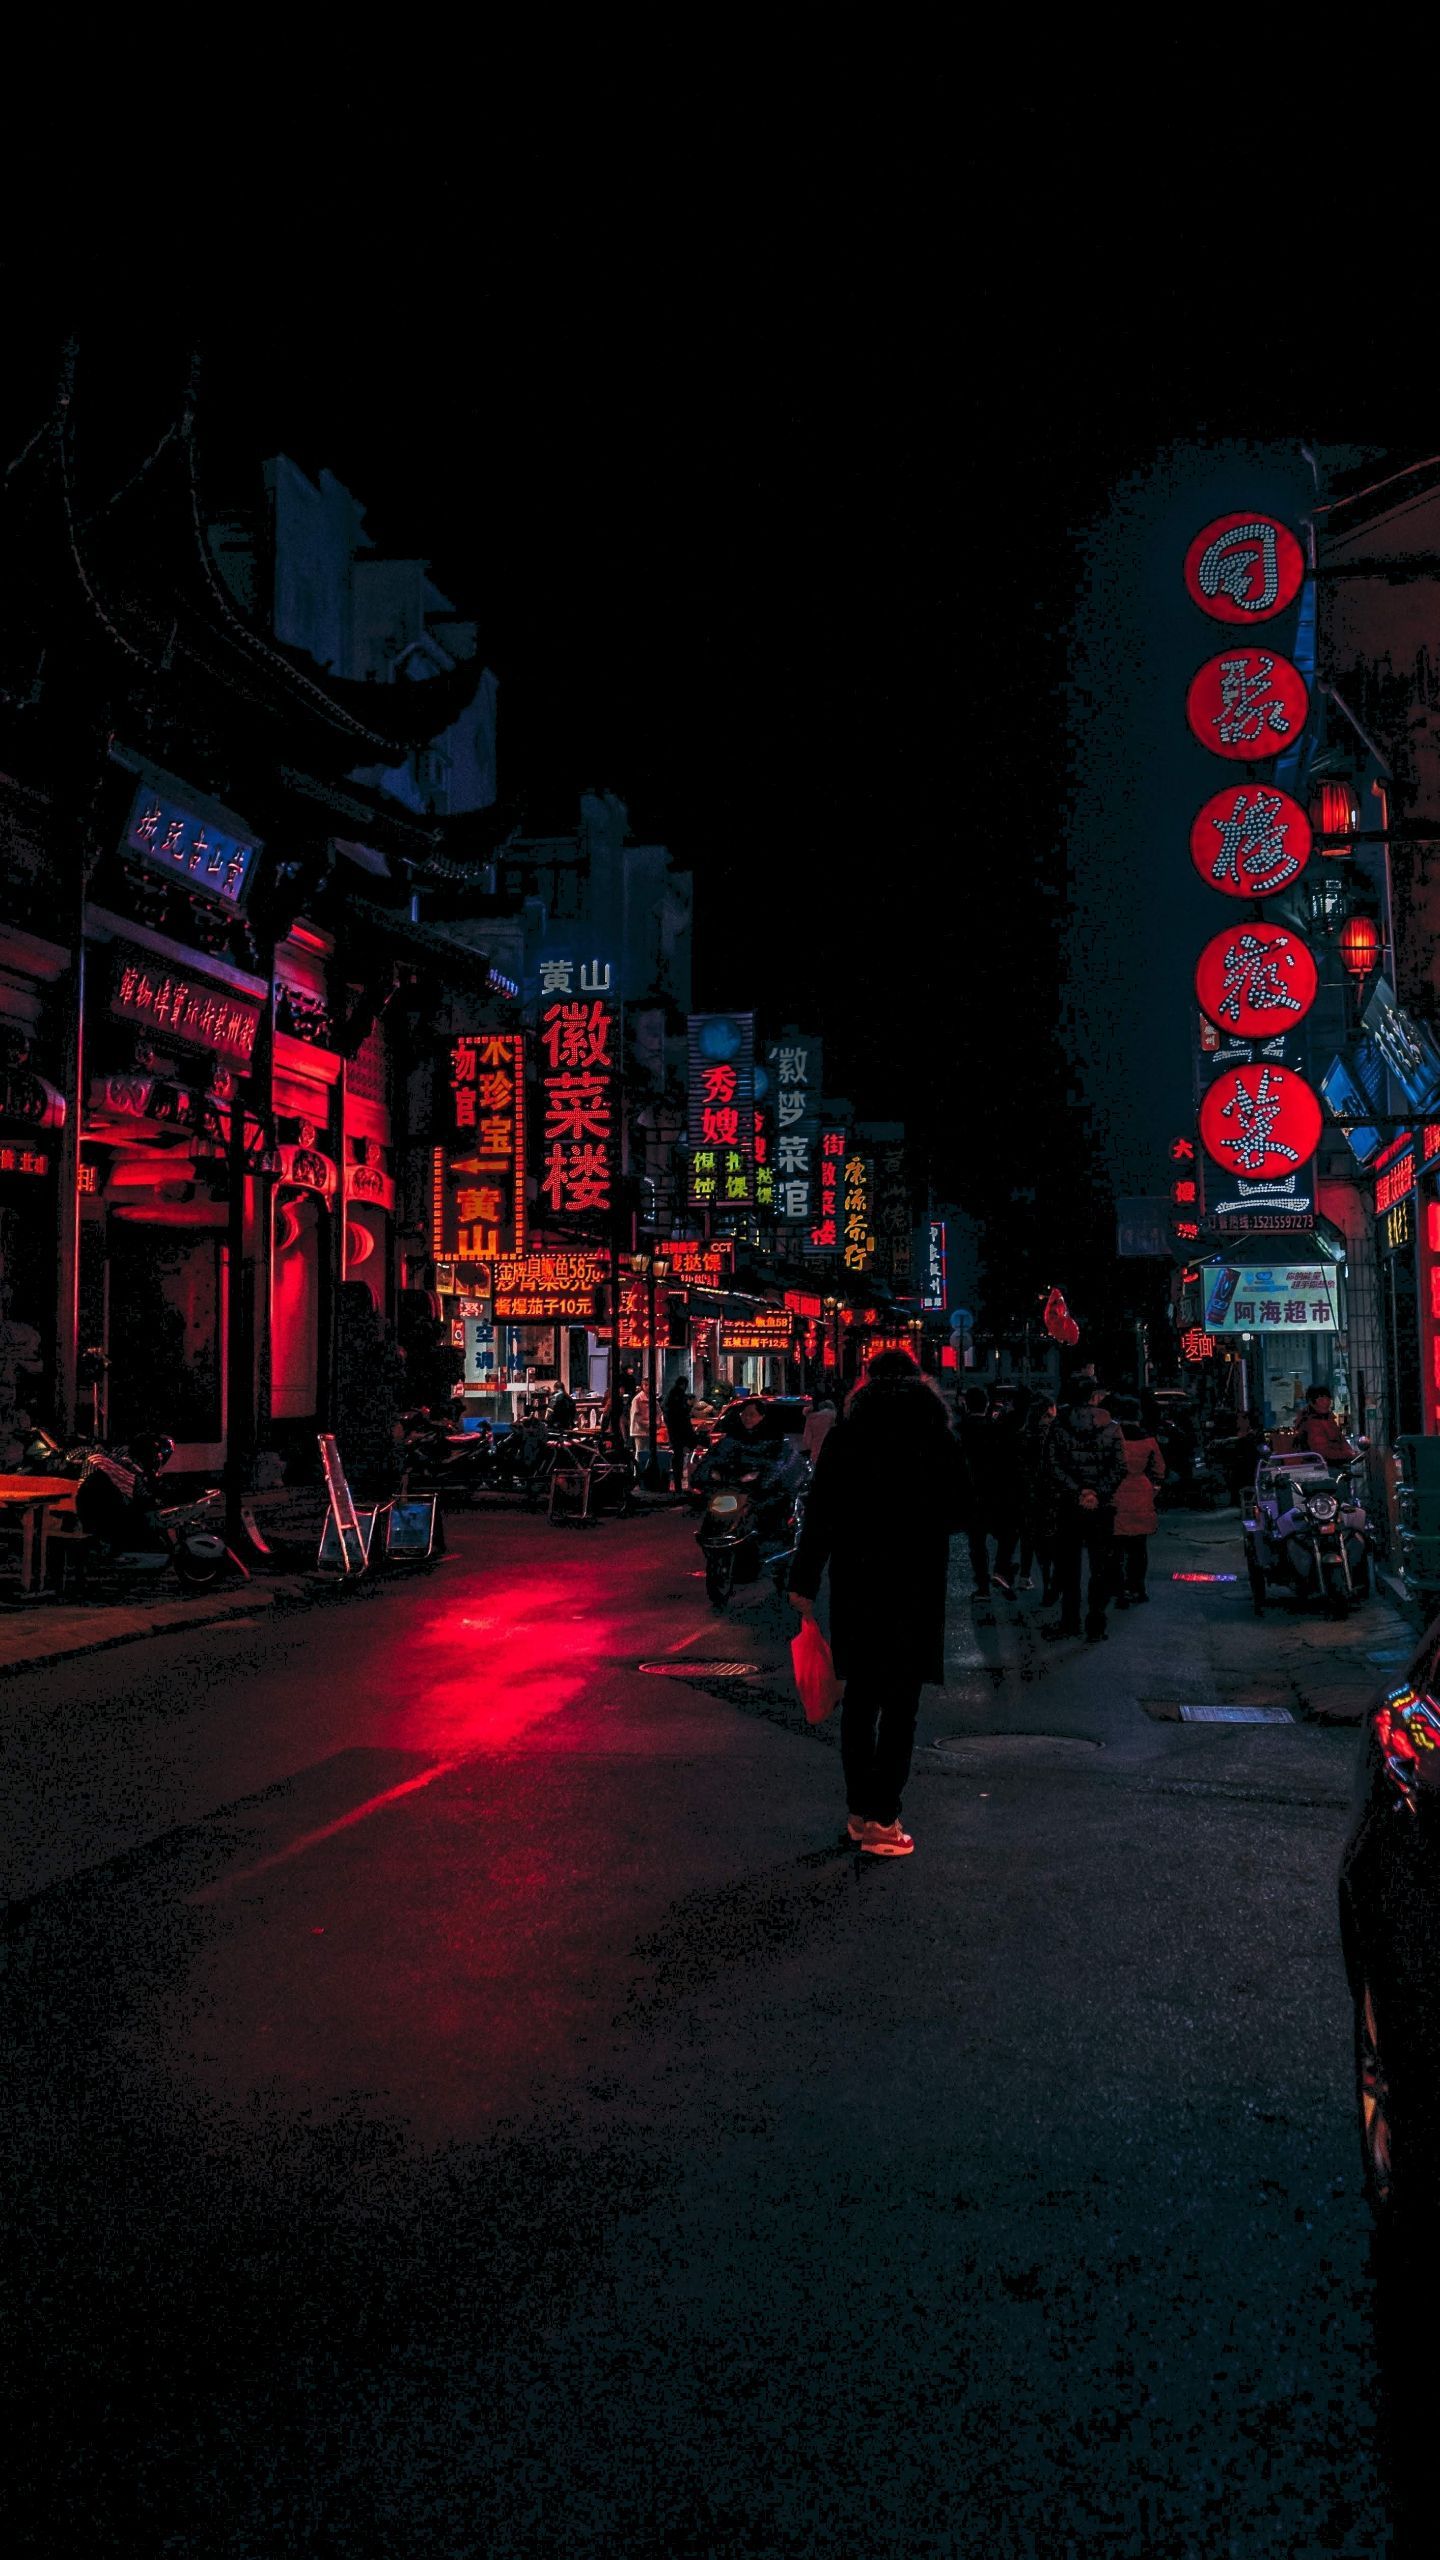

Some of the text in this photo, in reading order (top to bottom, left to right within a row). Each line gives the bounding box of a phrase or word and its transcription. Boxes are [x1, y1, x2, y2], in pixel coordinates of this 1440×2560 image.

[540, 960, 610, 994] 黄山
[543, 1001, 612, 1212] 徽菜楼
[701, 1064, 739, 1145] 秀嫂
[457, 1187, 501, 1255] 黄山
[1234, 1300, 1331, 1325] 阿海超市
[475, 1320, 494, 1370] 空调
